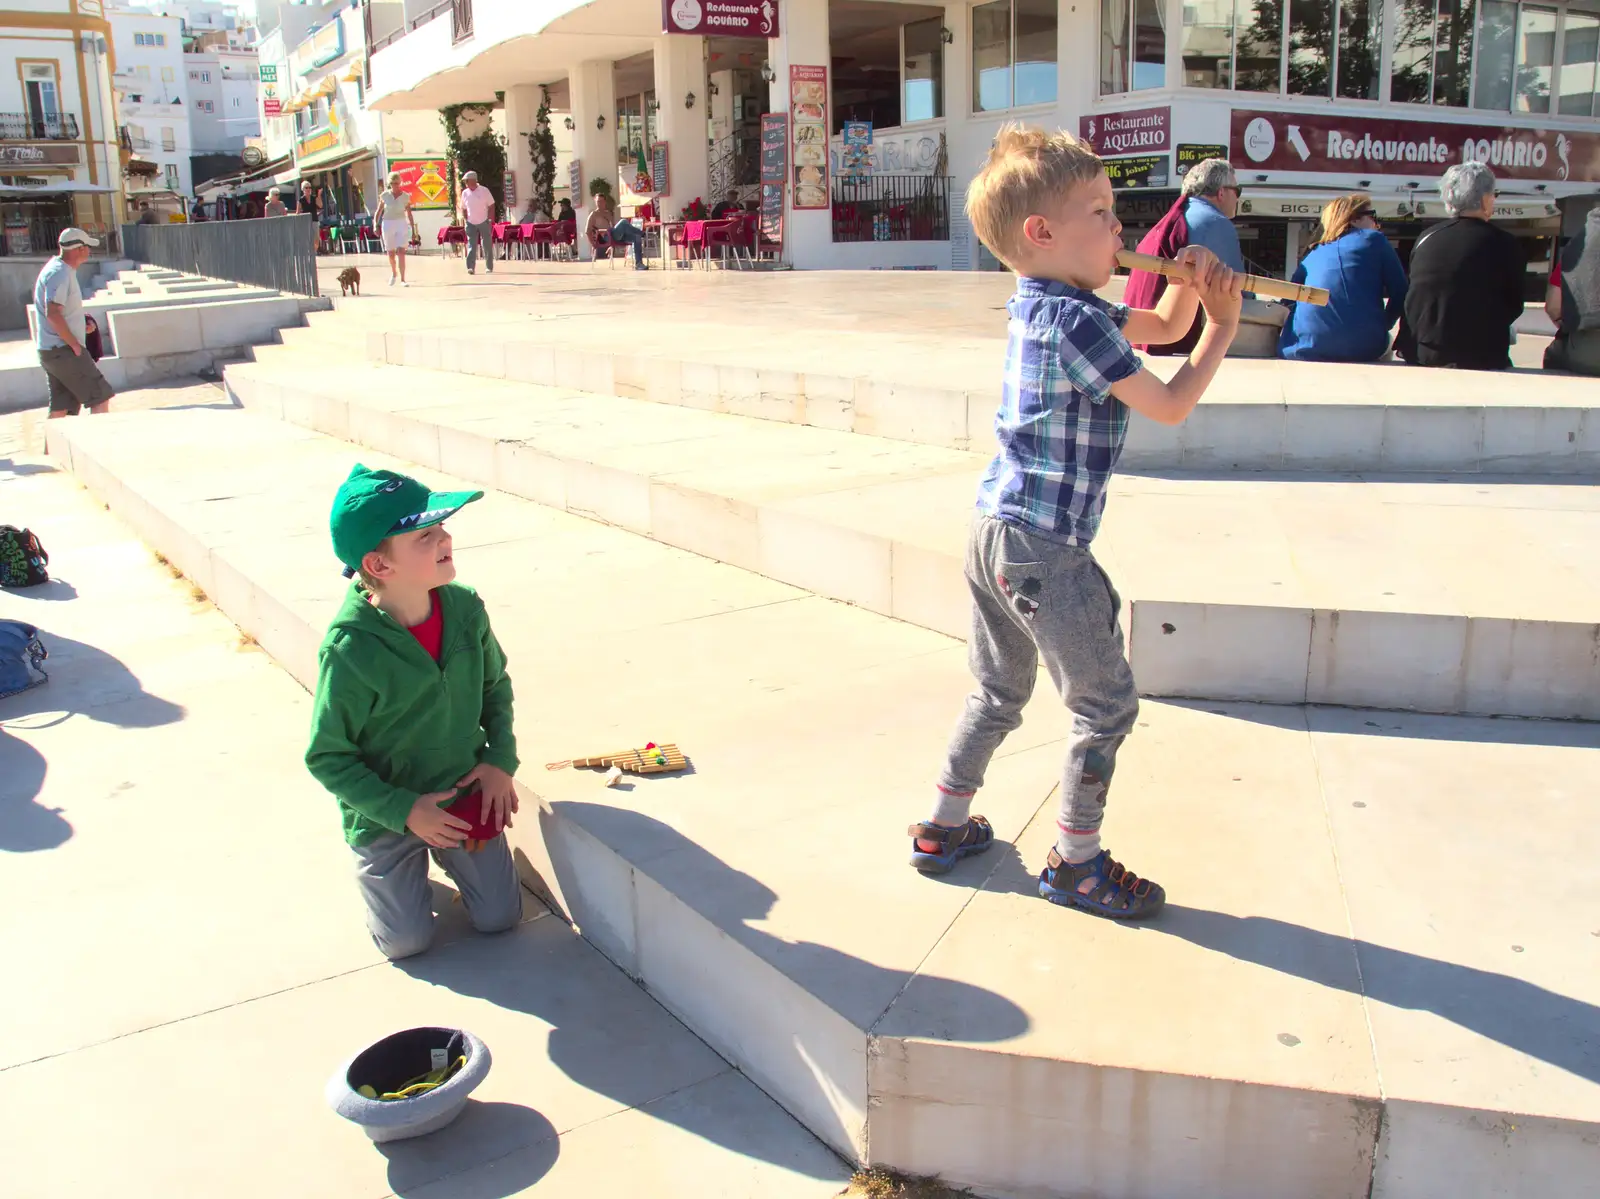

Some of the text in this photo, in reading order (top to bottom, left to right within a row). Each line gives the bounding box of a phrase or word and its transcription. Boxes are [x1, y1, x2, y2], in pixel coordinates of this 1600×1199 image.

[706, 2, 759, 14] Restaurante
[707, 15, 748, 26] AQUÁRIO
[261, 66, 276, 74] TEX
[261, 74, 277, 82] MEX
[1103, 114, 1164, 131] Restaurante
[1103, 129, 1165, 151] AQUÁRIO
[1327, 130, 1448, 163] Restaurante
[1463, 136, 1547, 167] AQUÁRIO
[1179, 150, 1195, 160] BIG
[1125, 162, 1154, 177] John's
[1281, 204, 1309, 213] BIG
[1492, 207, 1524, 216] HN'S
